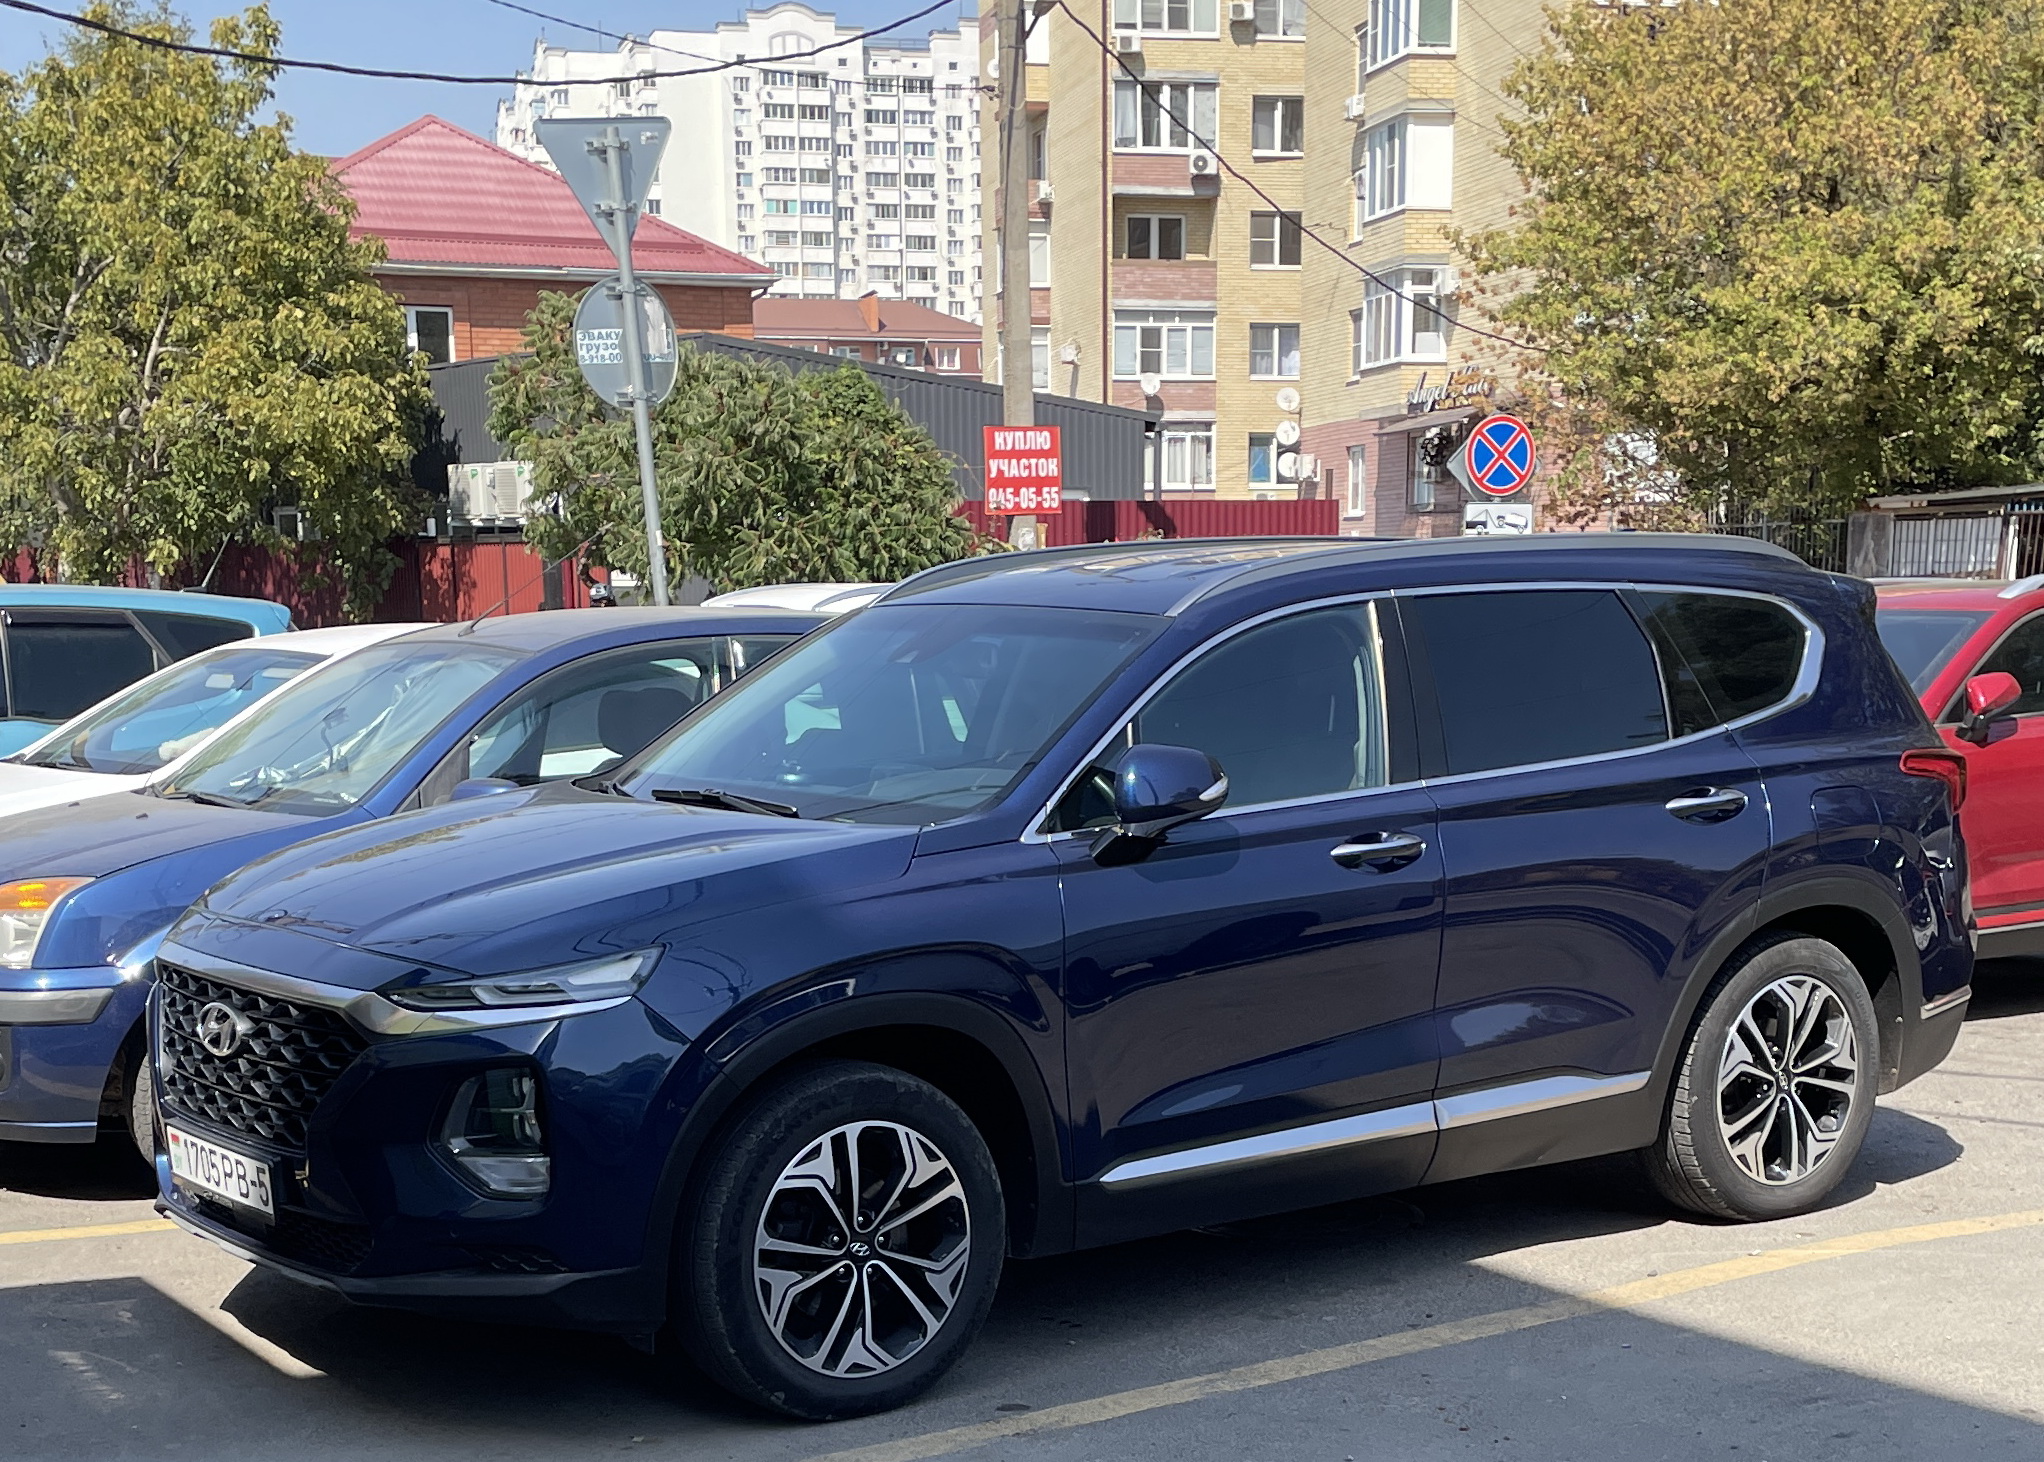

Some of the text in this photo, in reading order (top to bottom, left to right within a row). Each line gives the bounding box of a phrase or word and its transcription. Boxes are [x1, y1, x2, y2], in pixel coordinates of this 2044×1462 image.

[578, 331, 621, 341] ЭВАКУ
[580, 342, 618, 354] грузо
[994, 430, 1051, 450] КУПЛЮ
[988, 458, 1059, 478] УЧАСТОК
